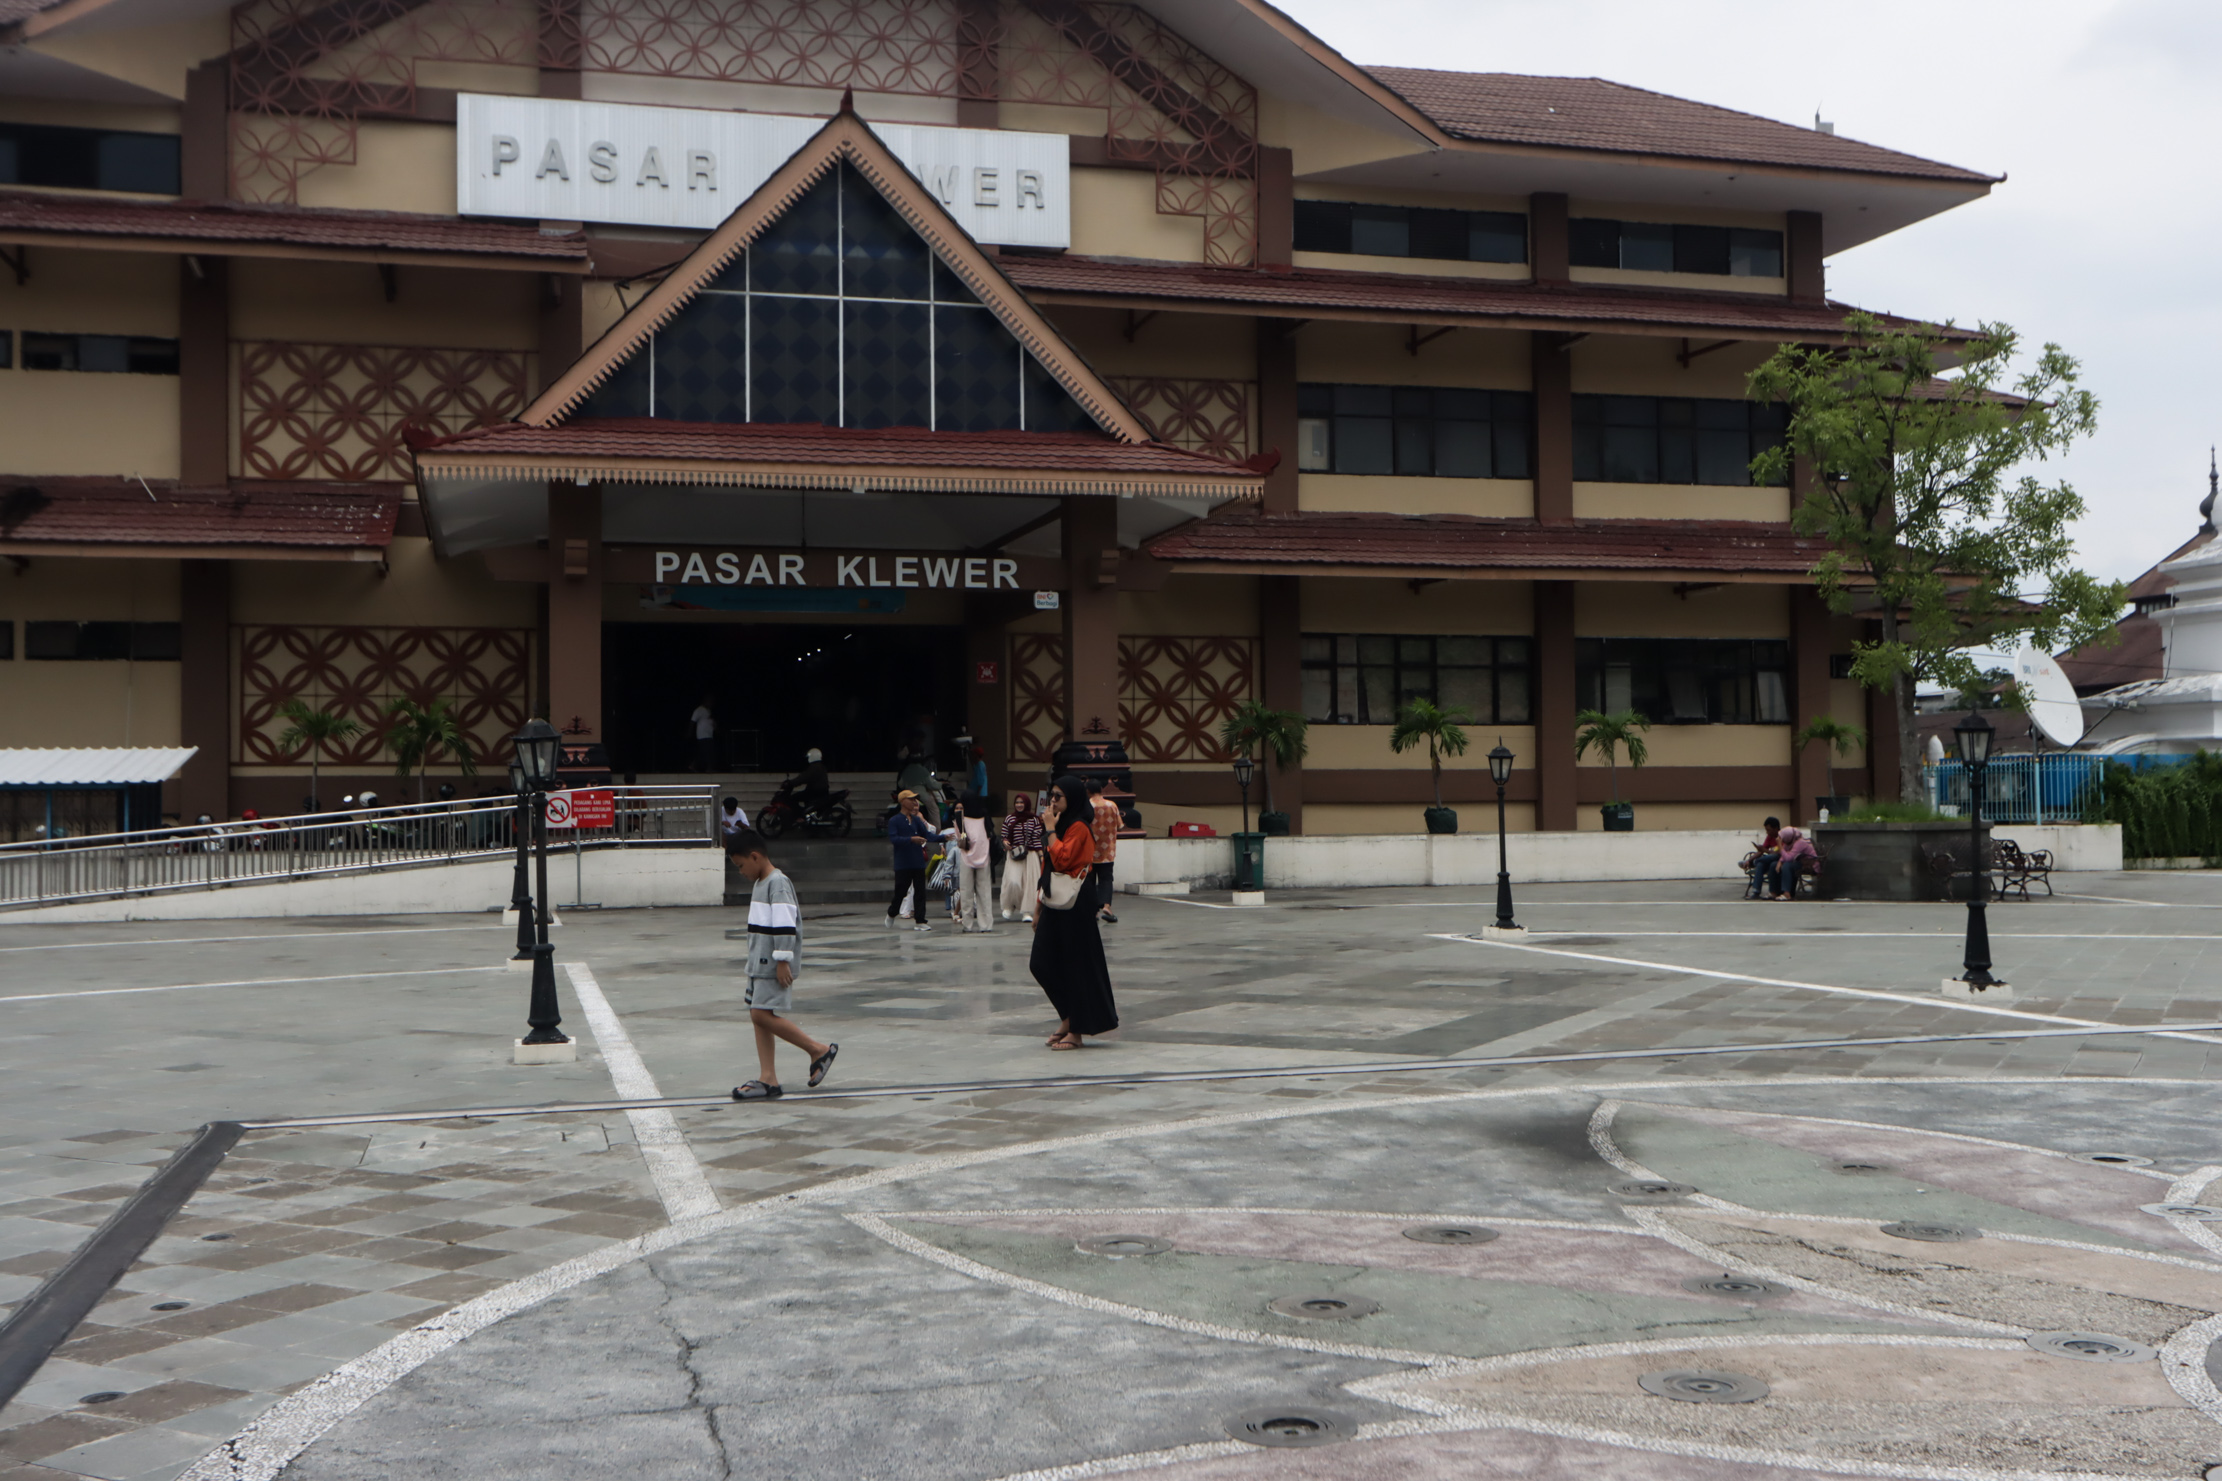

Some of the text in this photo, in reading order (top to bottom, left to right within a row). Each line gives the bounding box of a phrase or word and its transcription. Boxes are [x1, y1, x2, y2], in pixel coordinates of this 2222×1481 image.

[491, 133, 1045, 209] PASAR WER
[656, 551, 1020, 589] PASAR KLEWER
